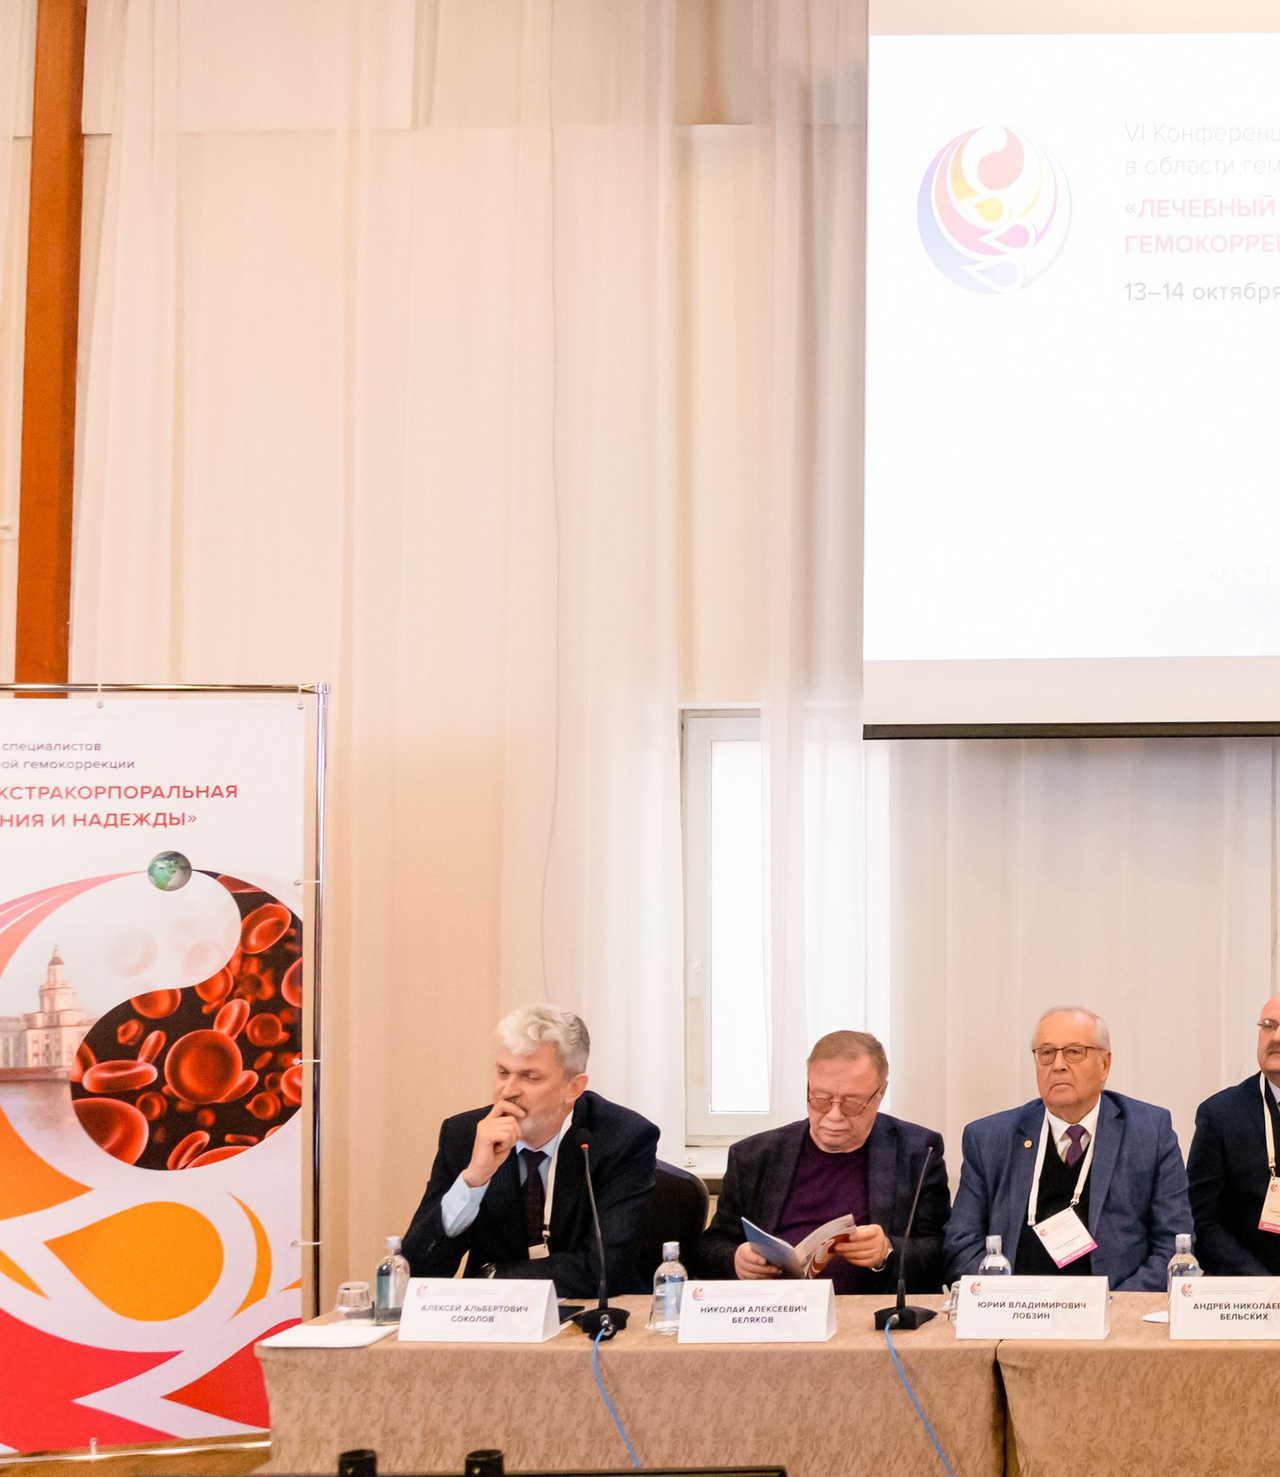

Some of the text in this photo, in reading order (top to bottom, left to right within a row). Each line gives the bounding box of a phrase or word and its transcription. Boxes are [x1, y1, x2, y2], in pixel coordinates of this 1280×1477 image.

[1125, 123, 1145, 142] VI
[1125, 159, 1136, 174] в
[1145, 155, 1234, 174] области
[1125, 194, 1275, 218] «ЛЕЧЕБНЫЙ
[2, 743, 101, 752] специалистов
[23, 761, 135, 771] гемокоррекции
[51, 814, 65, 827] И
[73, 812, 197, 829] НАДЕЖДЫ»
[421, 1304, 461, 1312] АЛЕКСЕЙ
[700, 1305, 807, 1313] НИКОЛАЙ АЛЕКСЕЕВИЧ
[977, 1301, 1087, 1309] ЮРИЙ ВЛАДИМИРОВИЧ
[1193, 1302, 1231, 1310] АНДРЕЙ
[451, 1315, 495, 1323] СОКОЛОВ
[732, 1316, 774, 1324] БЕЛЯКОВ
[1012, 1312, 1050, 1320] ЛОБЗИН
